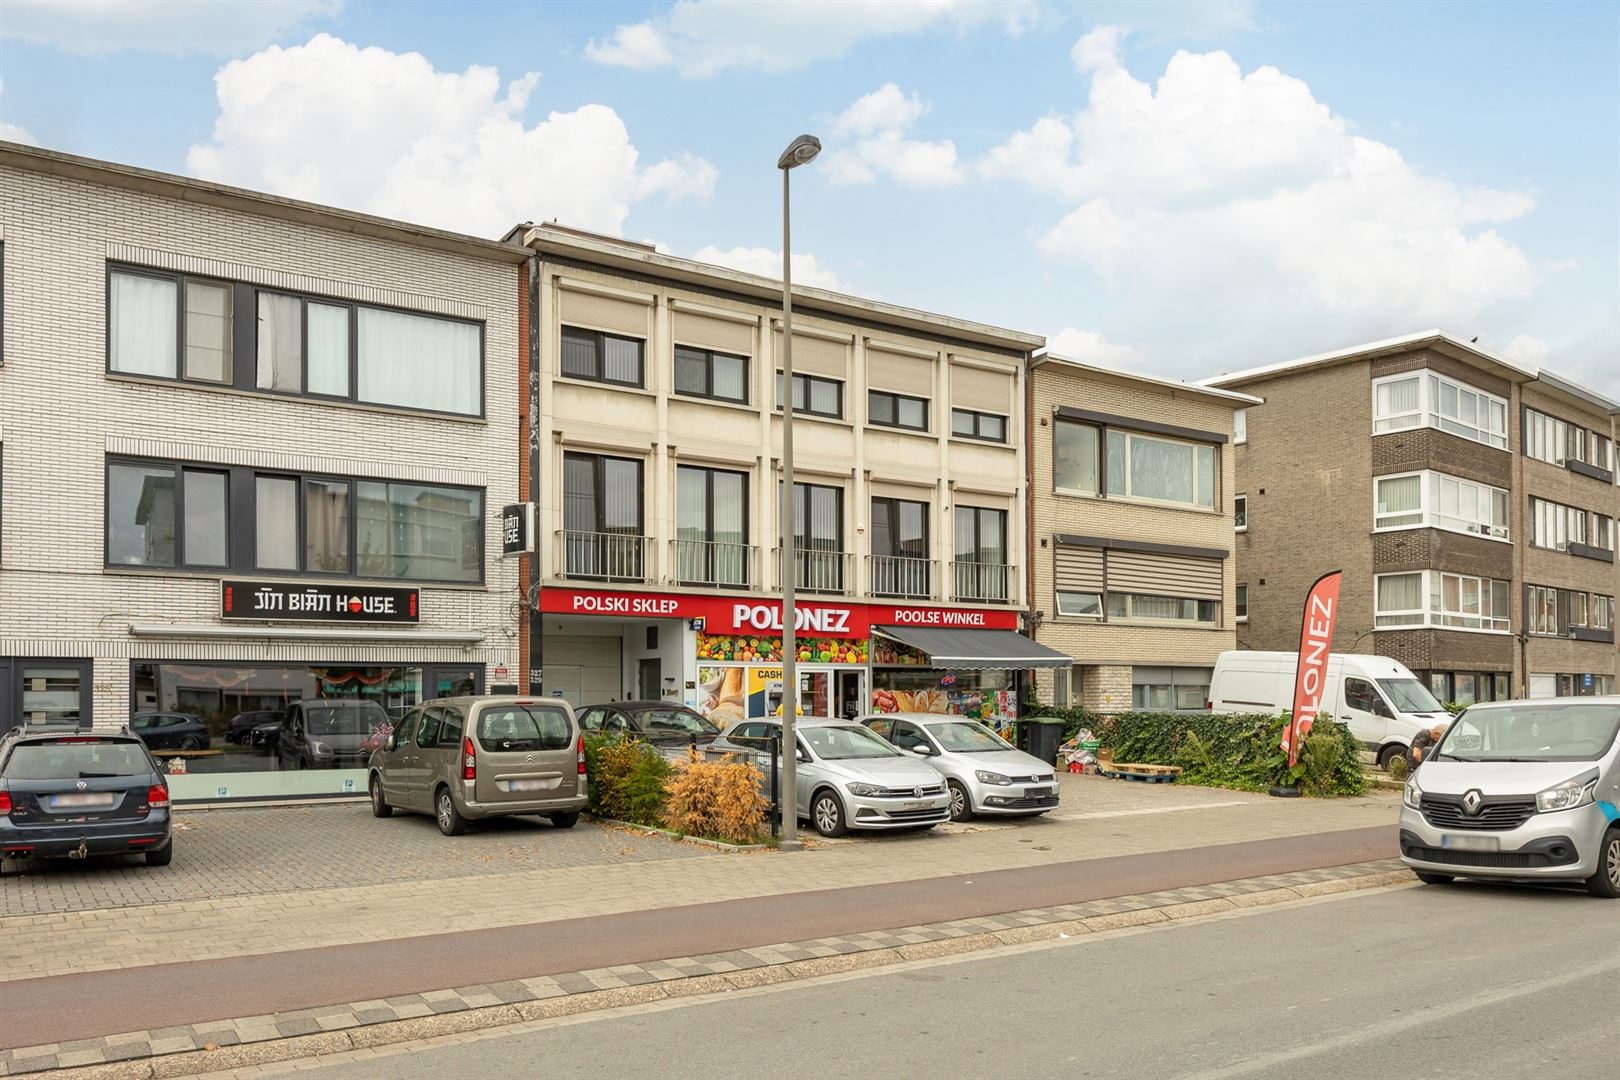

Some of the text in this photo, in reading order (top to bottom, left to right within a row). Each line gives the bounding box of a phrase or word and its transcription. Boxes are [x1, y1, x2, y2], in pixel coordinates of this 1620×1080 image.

[573, 595, 679, 614] POLSKI SKLEP
[895, 610, 986, 626] POOLSE WINKEL
[757, 670, 783, 679] CASH
[1295, 594, 1332, 740] OLONEZ
